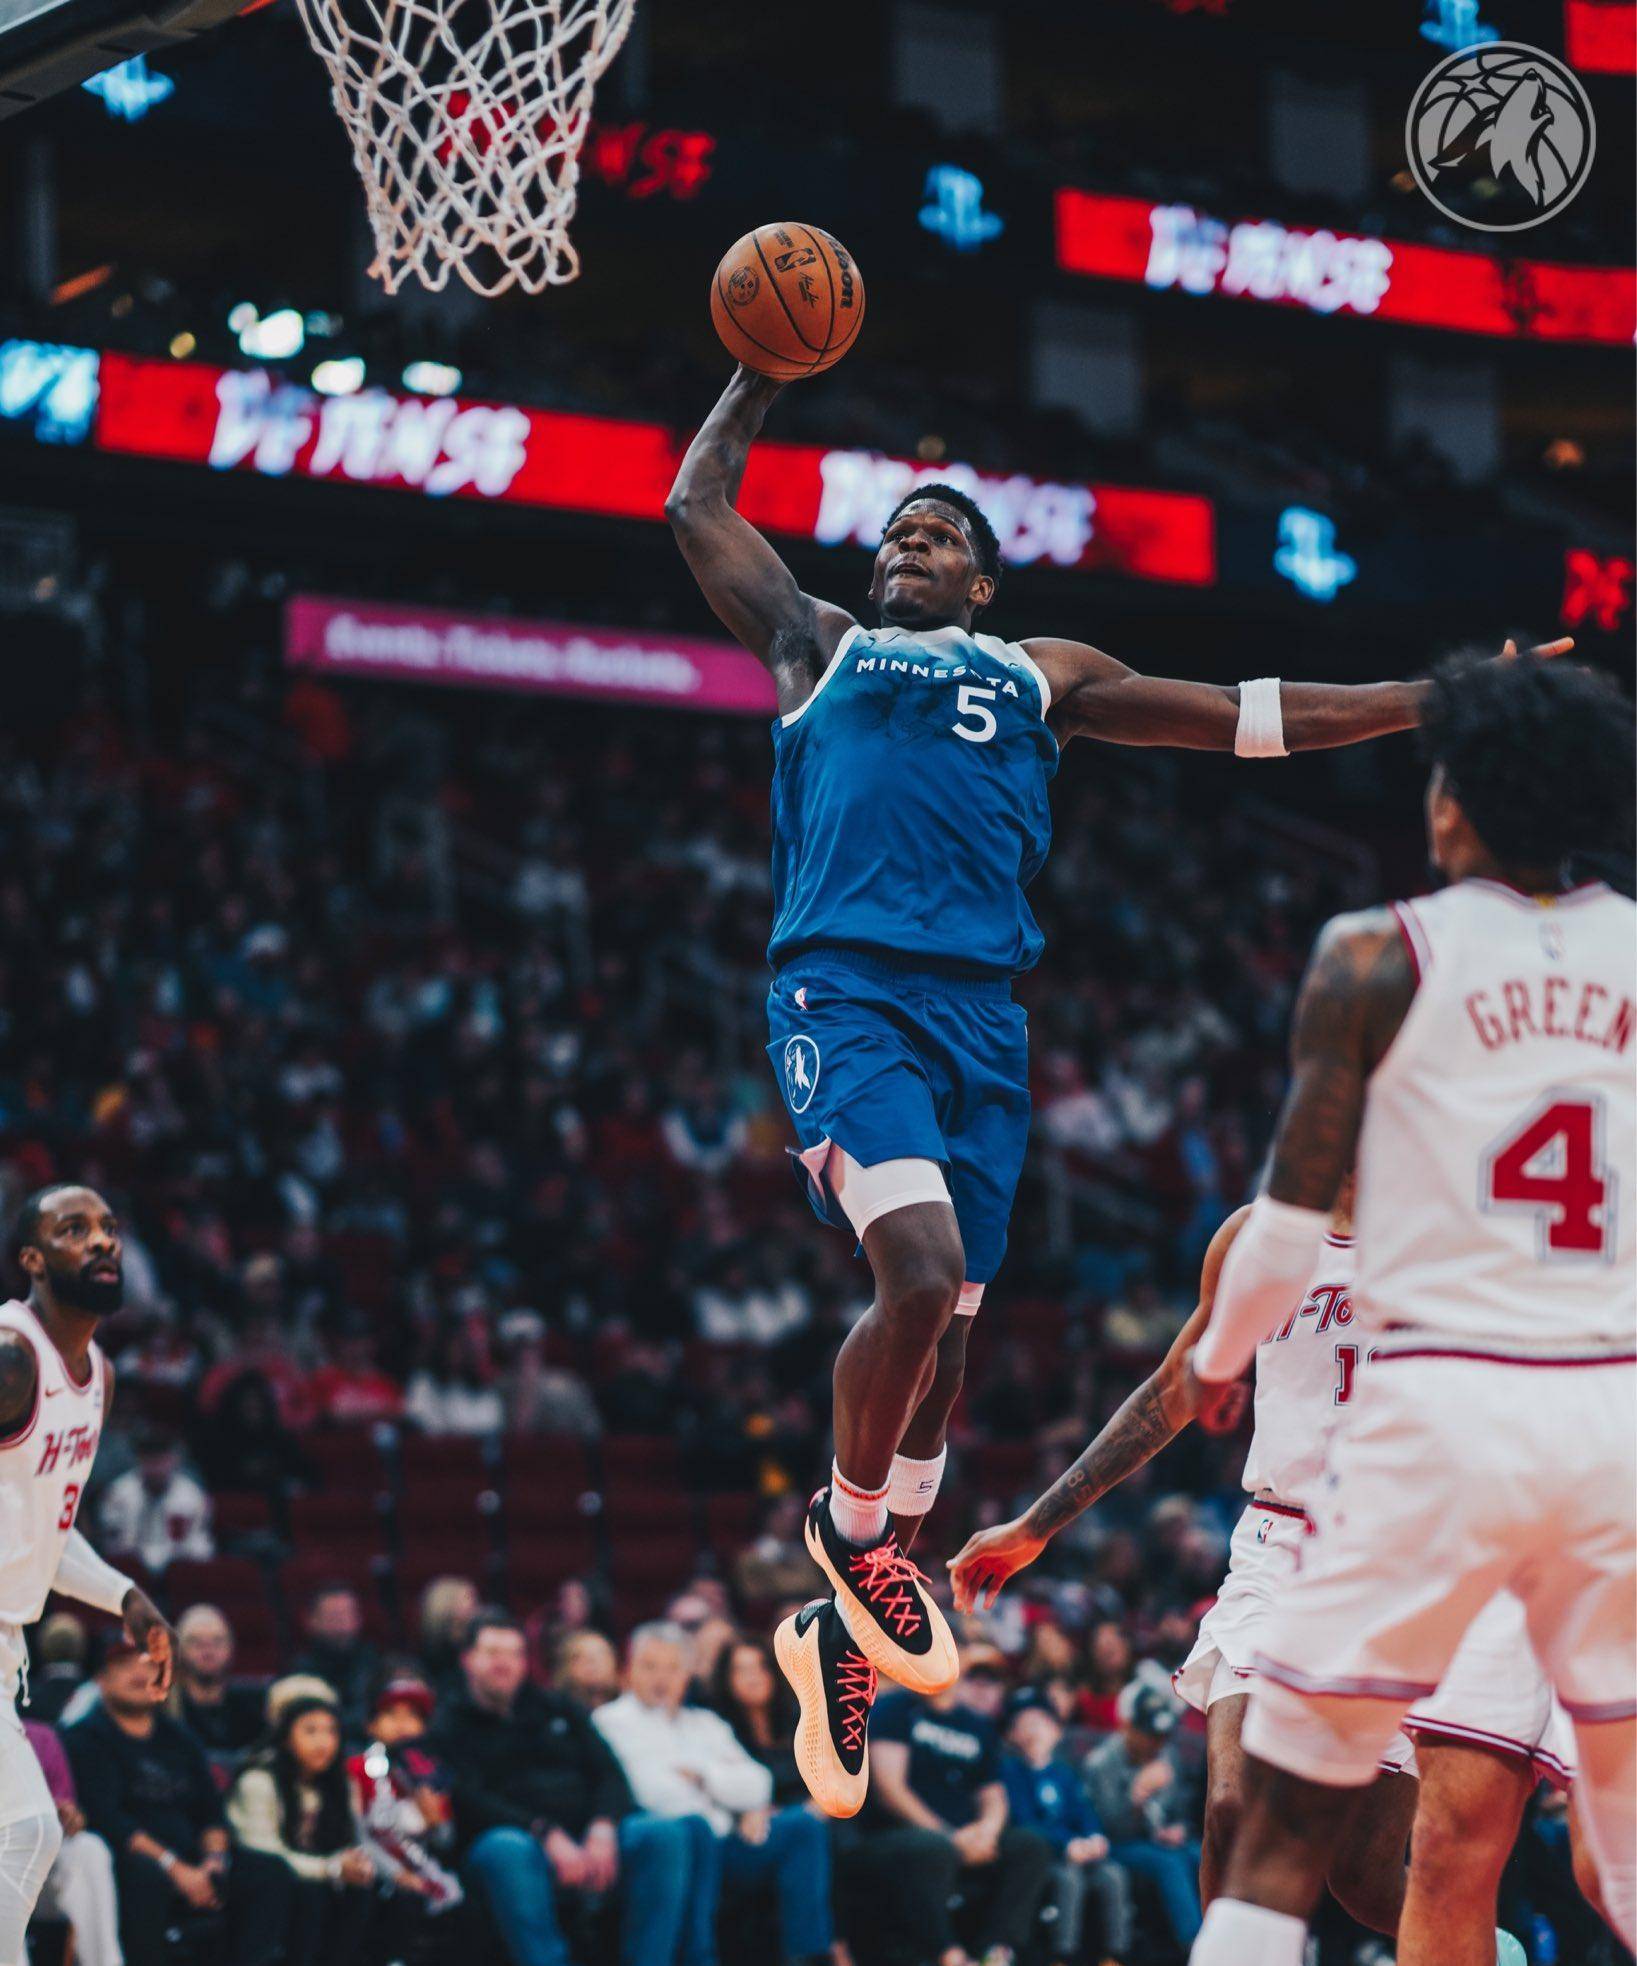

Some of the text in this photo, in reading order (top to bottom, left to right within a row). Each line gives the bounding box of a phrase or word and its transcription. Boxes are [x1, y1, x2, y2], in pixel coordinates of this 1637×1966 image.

[856, 657, 1019, 699] MINNESTA
[952, 684, 998, 743] 5
[1465, 976, 1637, 1054] GREEN
[1479, 1088, 1618, 1262] 4
